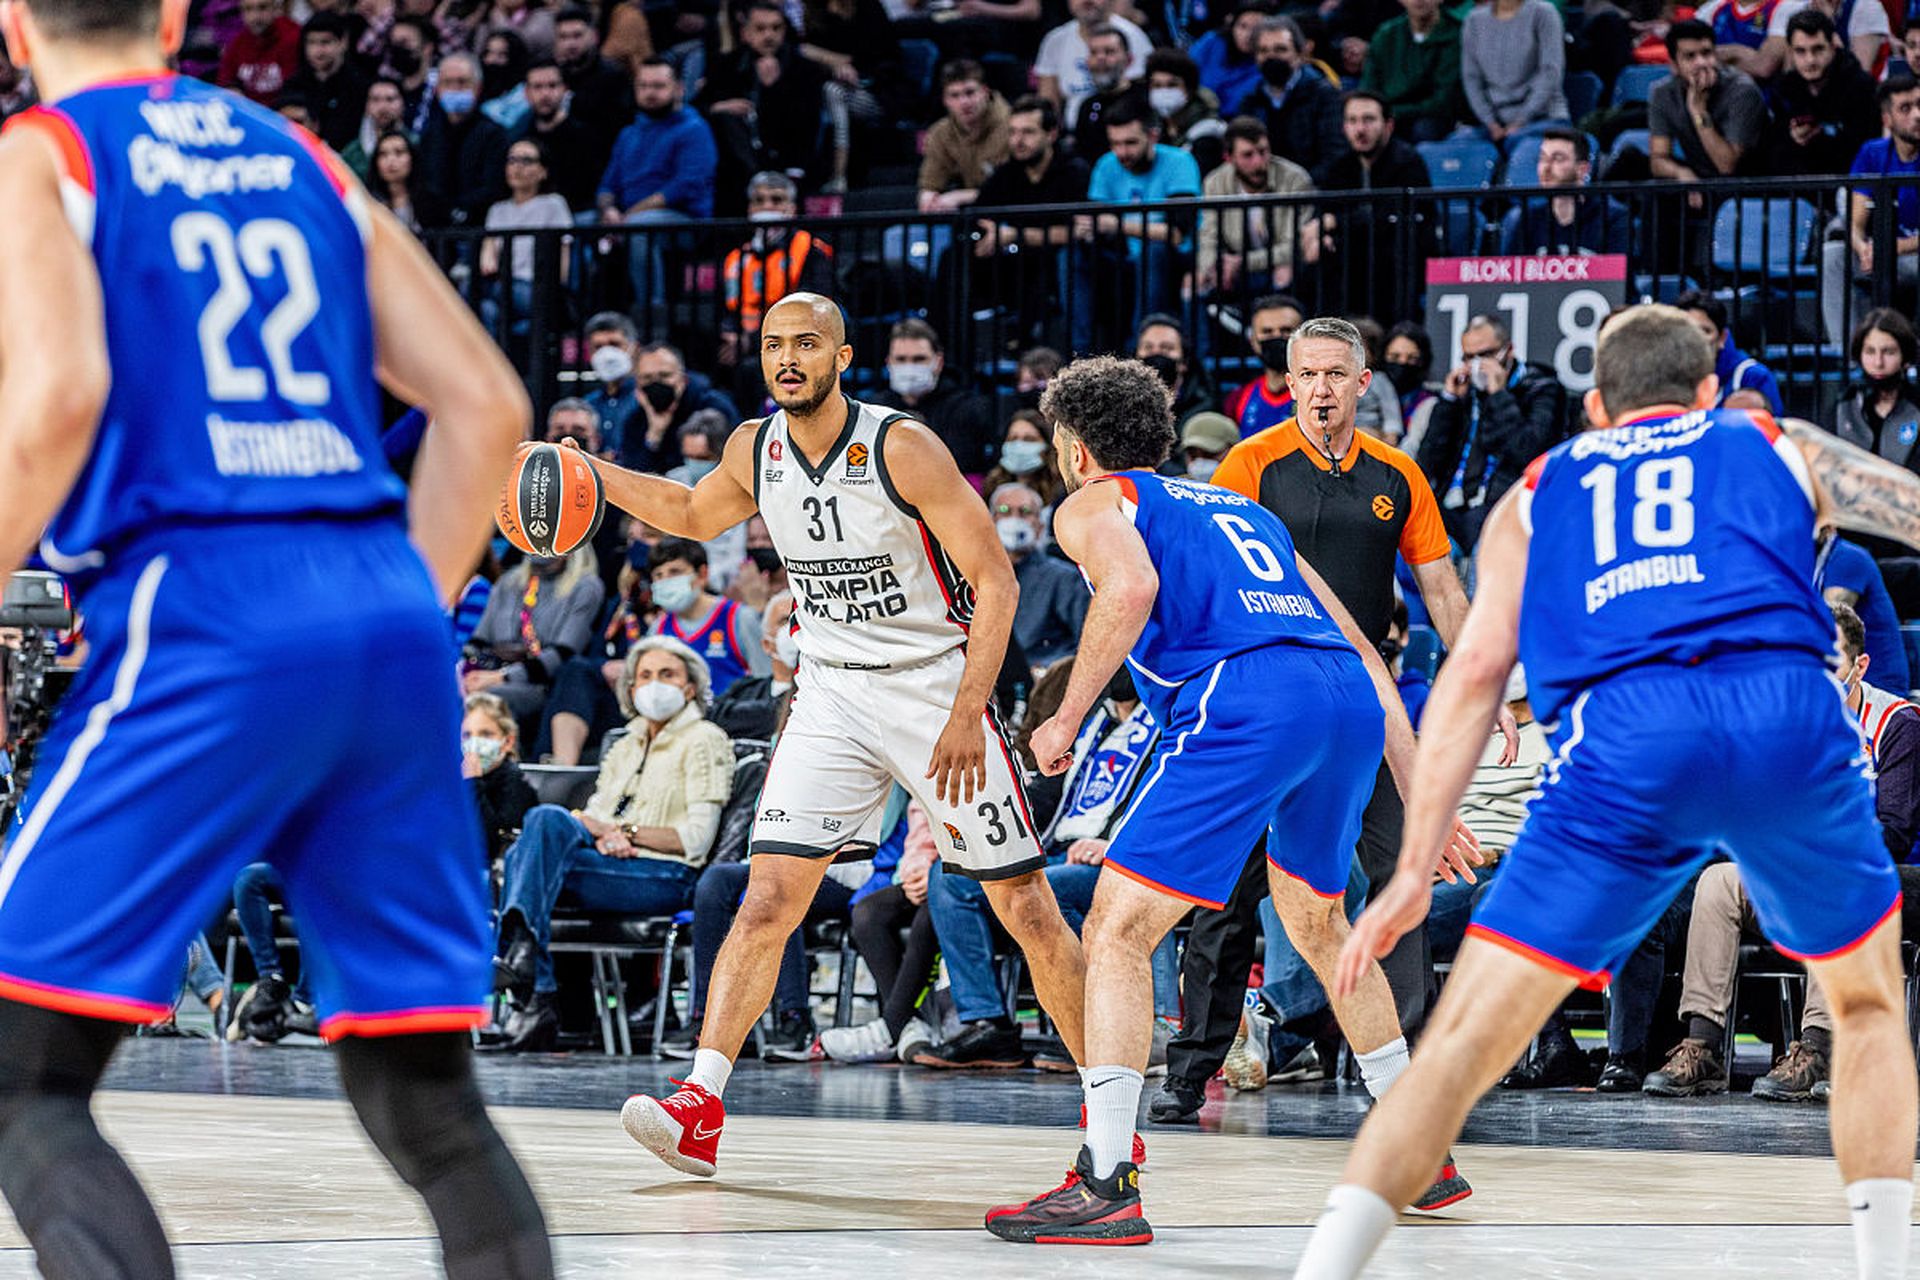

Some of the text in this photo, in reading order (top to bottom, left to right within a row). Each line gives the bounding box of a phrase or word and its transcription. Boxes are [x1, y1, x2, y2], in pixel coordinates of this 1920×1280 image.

[1460, 259, 1589, 283] BLOK BLOCK
[170, 211, 330, 405] 22
[1437, 289, 1611, 391] 118
[803, 496, 844, 542] 31
[1580, 455, 1695, 567] 18
[827, 556, 892, 574] EXCHANGE
[1212, 513, 1284, 582] 6
[803, 593, 907, 624] MLANO
[977, 795, 1028, 846] 31
